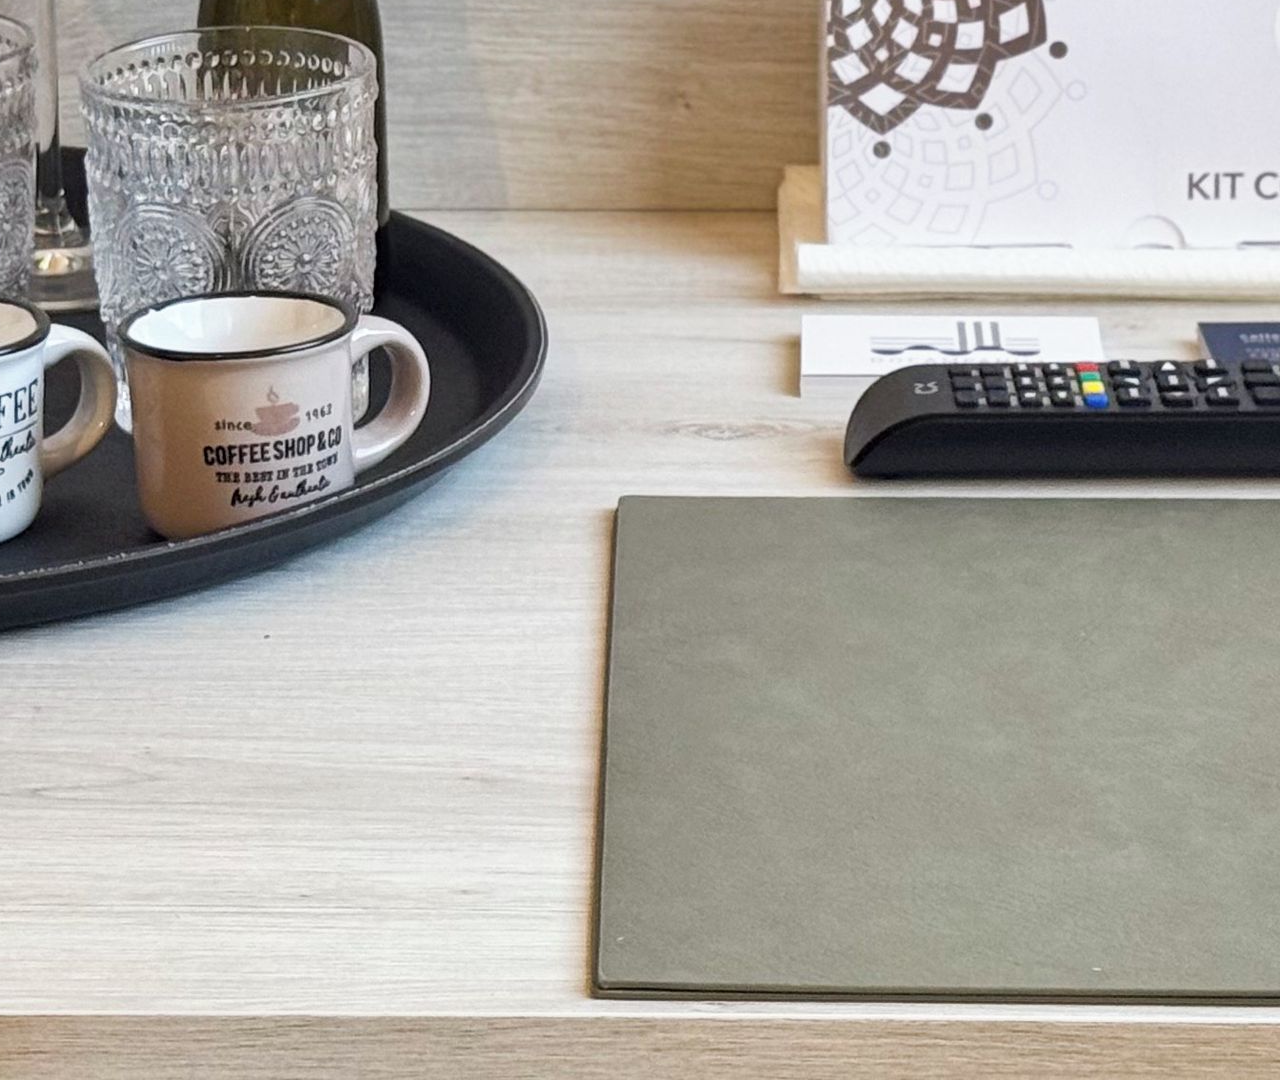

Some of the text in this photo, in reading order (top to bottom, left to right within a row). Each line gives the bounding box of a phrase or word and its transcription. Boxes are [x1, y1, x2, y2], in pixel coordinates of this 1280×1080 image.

[1187, 172, 1244, 200] KIT
[214, 419, 253, 432] since
[203, 425, 342, 466] COFFEE SHOP & CO
[215, 471, 241, 484] THE
[244, 471, 274, 484] BEST
[277, 469, 290, 481] IN
[293, 463, 314, 478] THE
